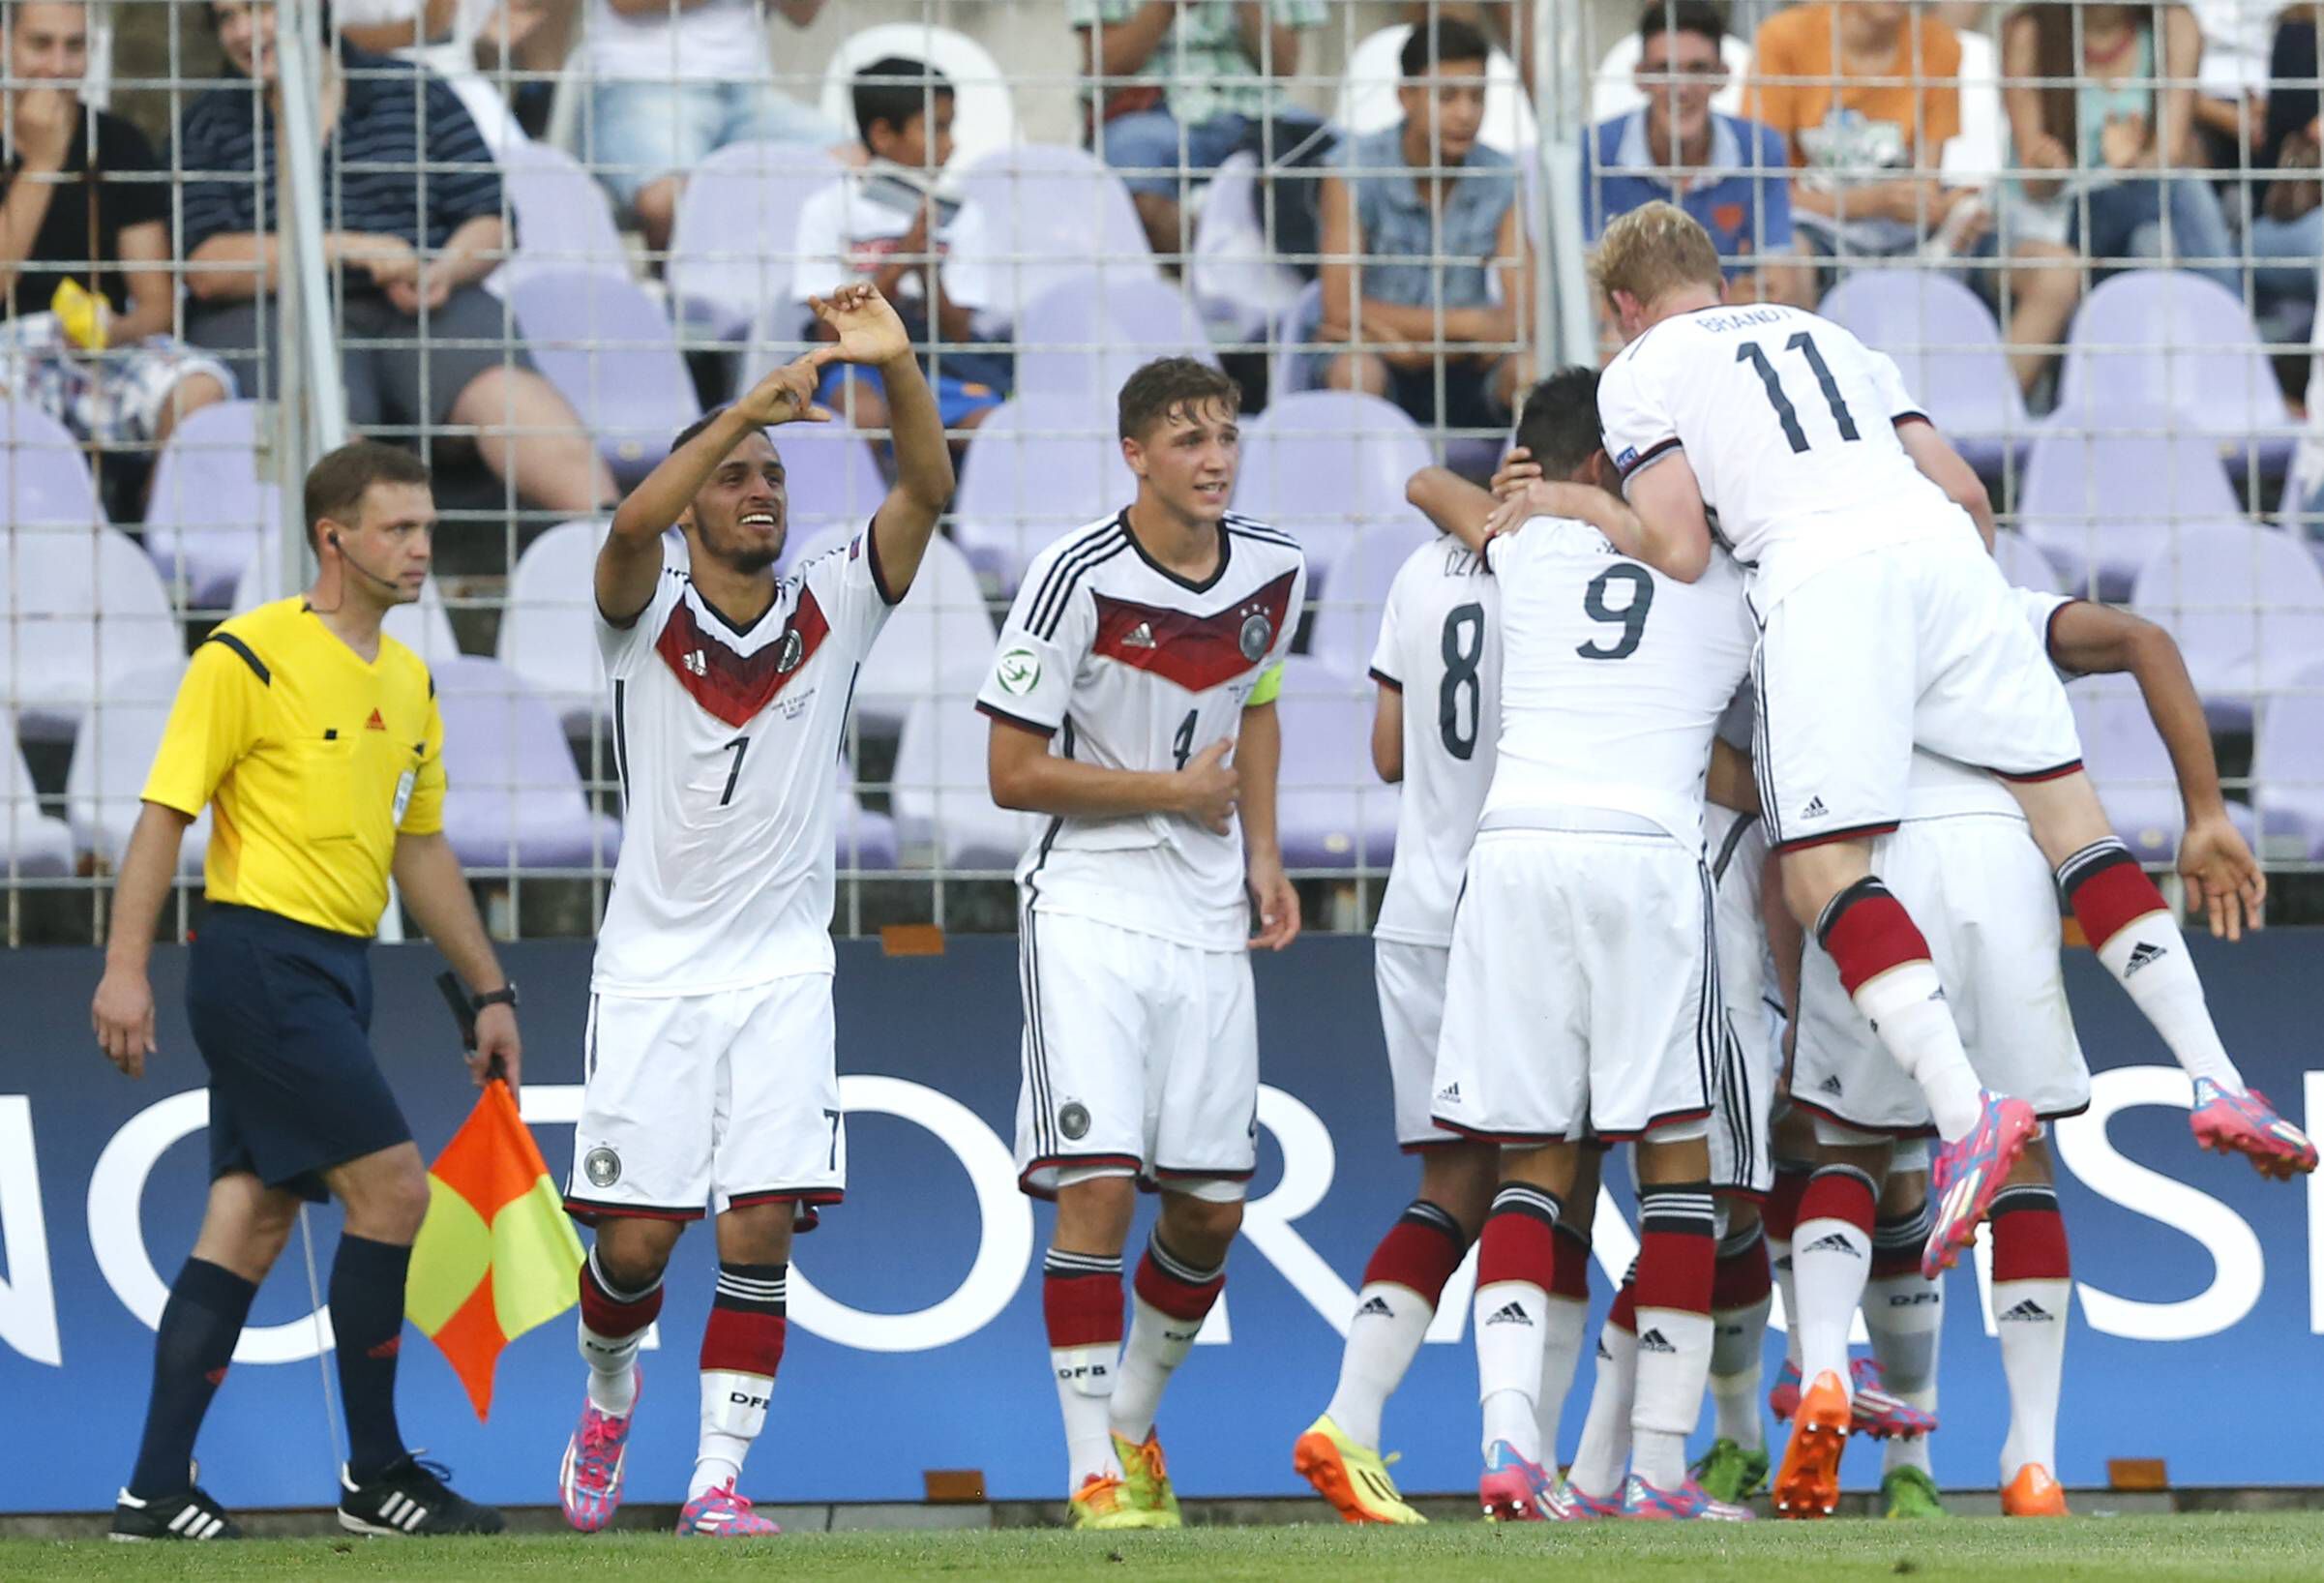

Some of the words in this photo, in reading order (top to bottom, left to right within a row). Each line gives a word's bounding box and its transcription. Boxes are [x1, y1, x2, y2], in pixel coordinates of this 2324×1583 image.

[1736, 331, 1862, 454] 11
[1576, 562, 1654, 660] 9
[1440, 602, 1485, 761] 8
[720, 736, 750, 806] 7
[1173, 708, 1199, 772] 4
[823, 1108, 842, 1172] 7
[1058, 1365, 1106, 1379] DFB
